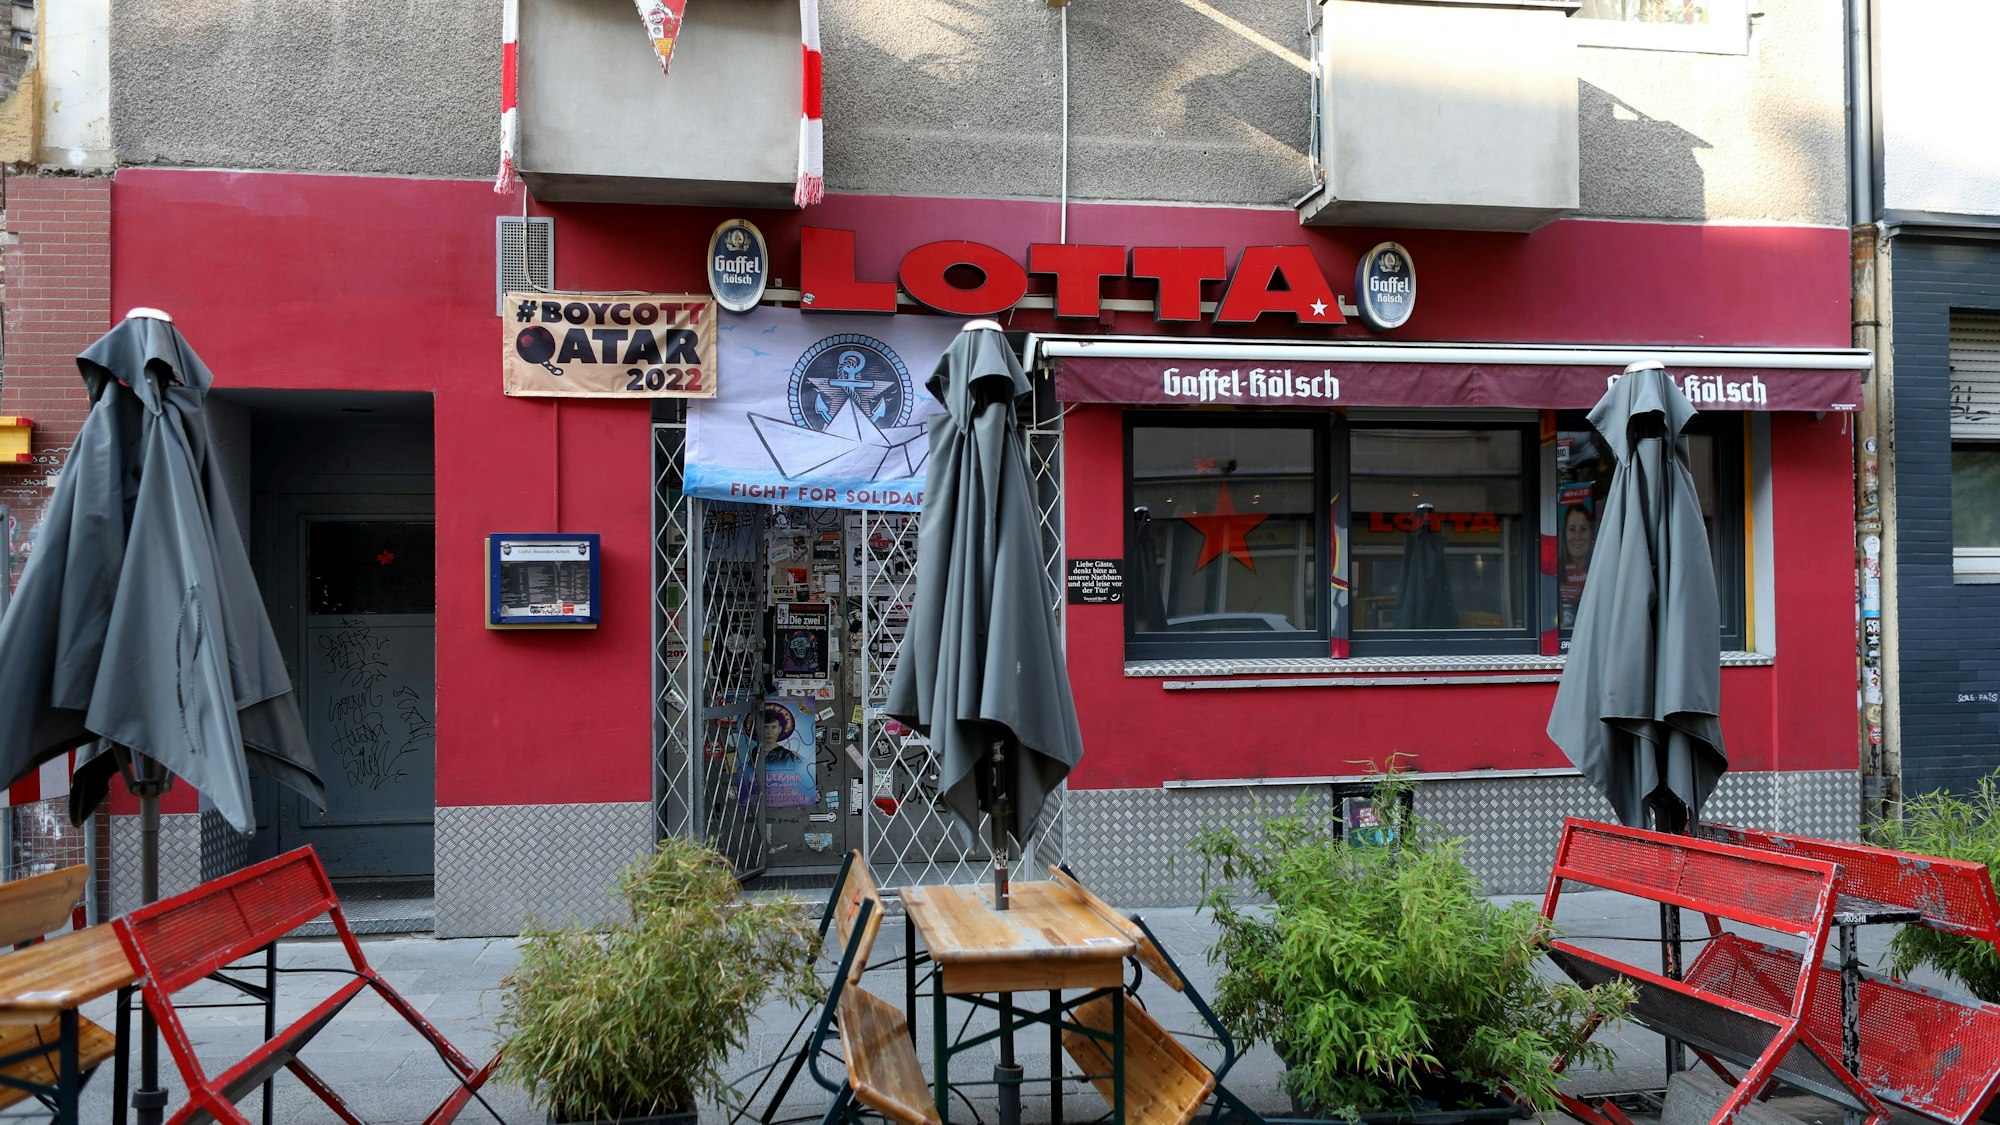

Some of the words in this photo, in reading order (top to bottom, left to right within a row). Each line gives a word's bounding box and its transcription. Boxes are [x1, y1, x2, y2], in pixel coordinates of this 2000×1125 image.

[715, 254, 761, 274] Gaffel
[723, 273, 752, 285] Kölsch
[800, 225, 1347, 326] LOTTA
[1370, 275, 1410, 293] Gaffel
[1377, 293, 1403, 304] Kölsch
[516, 299, 706, 326] #BOYCOTT
[626, 367, 702, 391] 2022
[1163, 367, 1340, 401] Gaffel-Kölsch
[730, 482, 790, 498] FIGHT
[799, 487, 837, 503] FOR
[1369, 510, 1503, 533] LOTTA
[1095, 561, 1115, 569] Gäste,
[1082, 580, 1095, 588] seid
[1096, 580, 1111, 588] leise
[789, 615, 802, 625] Die
